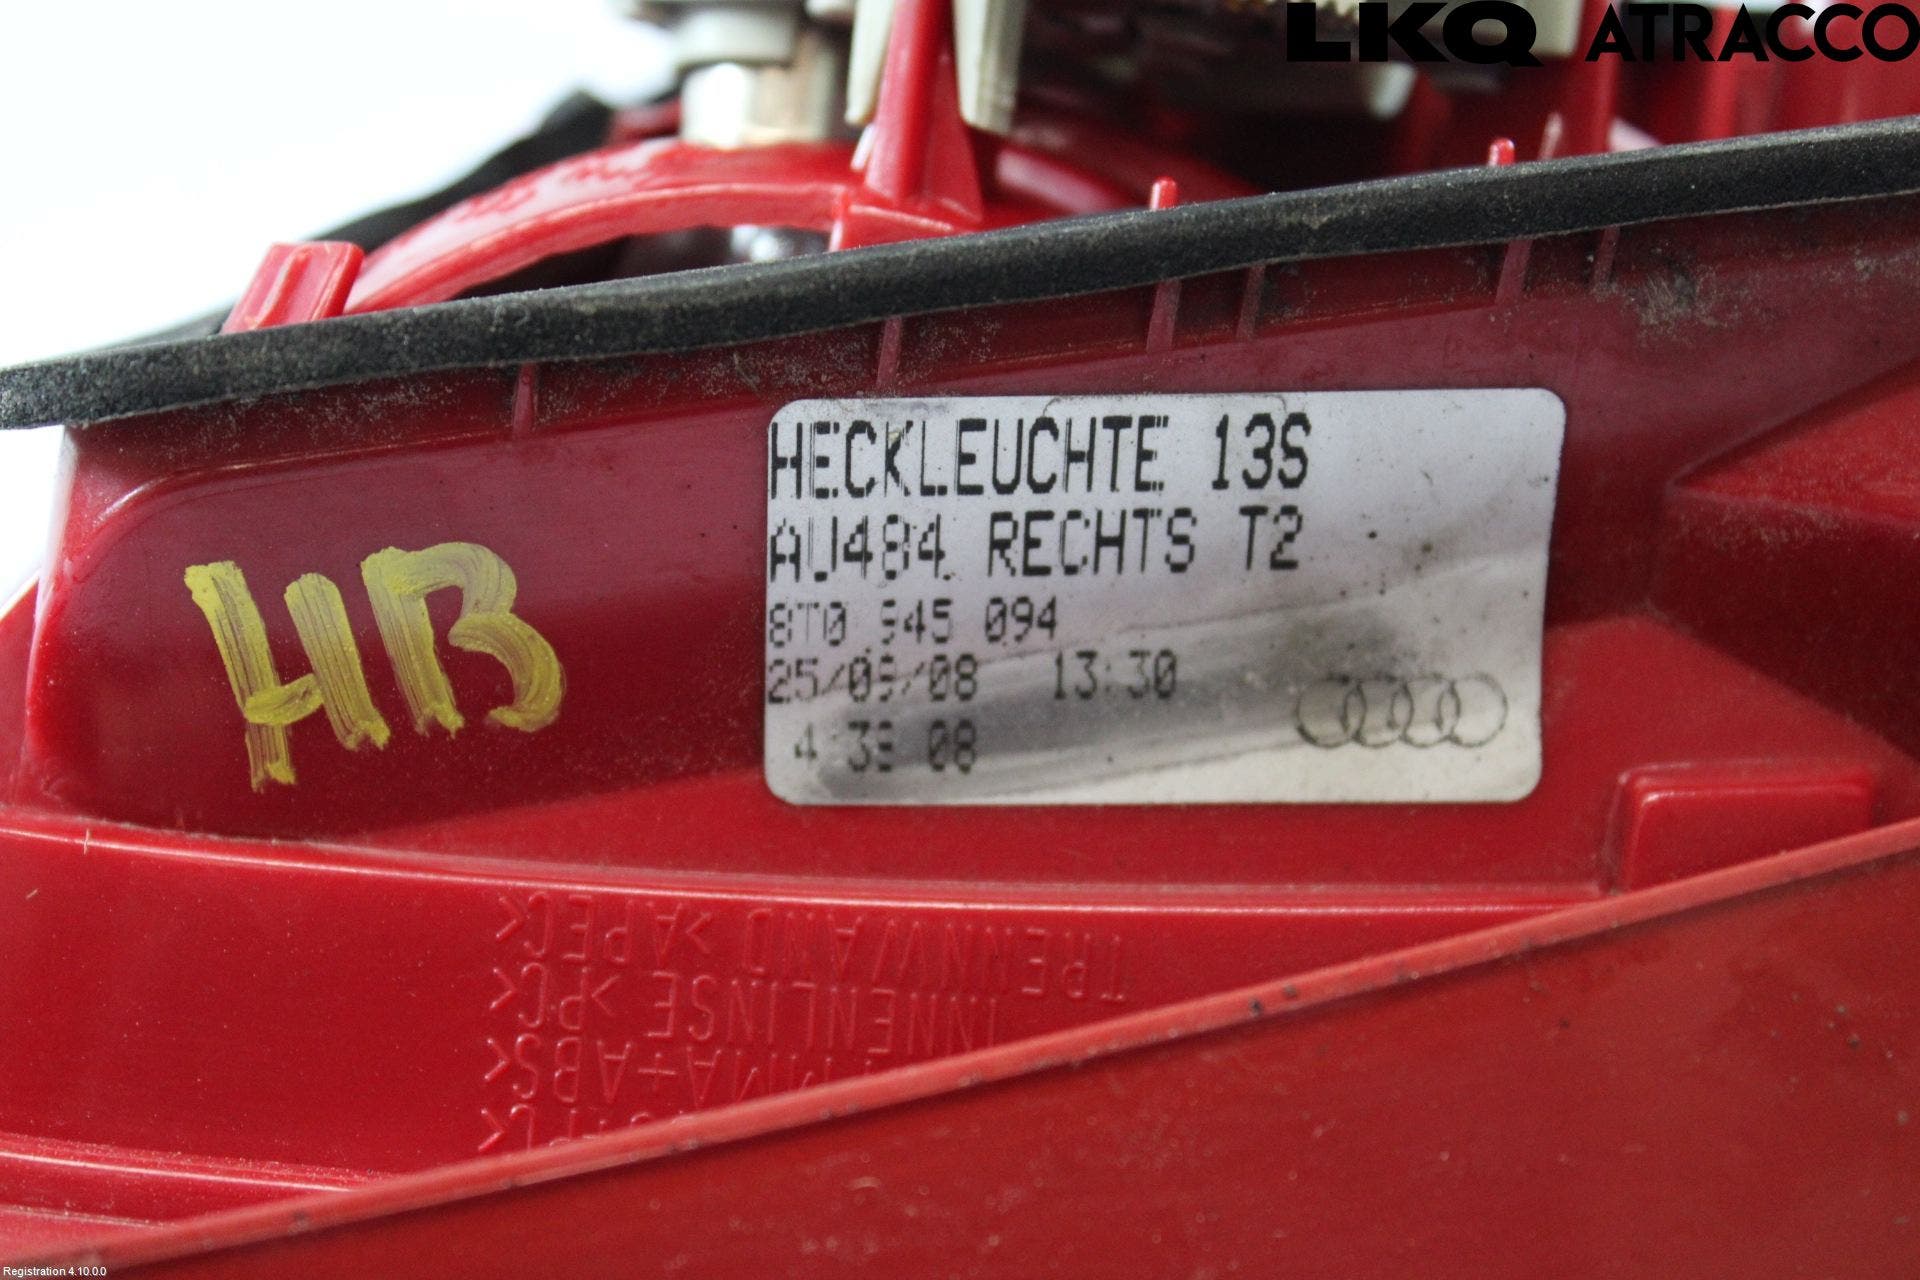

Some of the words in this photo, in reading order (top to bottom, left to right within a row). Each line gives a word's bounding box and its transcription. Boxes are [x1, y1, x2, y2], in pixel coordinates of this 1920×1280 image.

[771, 414, 1168, 499] HECKLEUCHTE
[1212, 412, 1311, 491] 13S
[770, 511, 947, 583] AU484
[987, 507, 1196, 579] RECHTS
[1238, 504, 1303, 571] T2
[985, 595, 1058, 645] 094
[1053, 649, 1177, 700] 13:30
